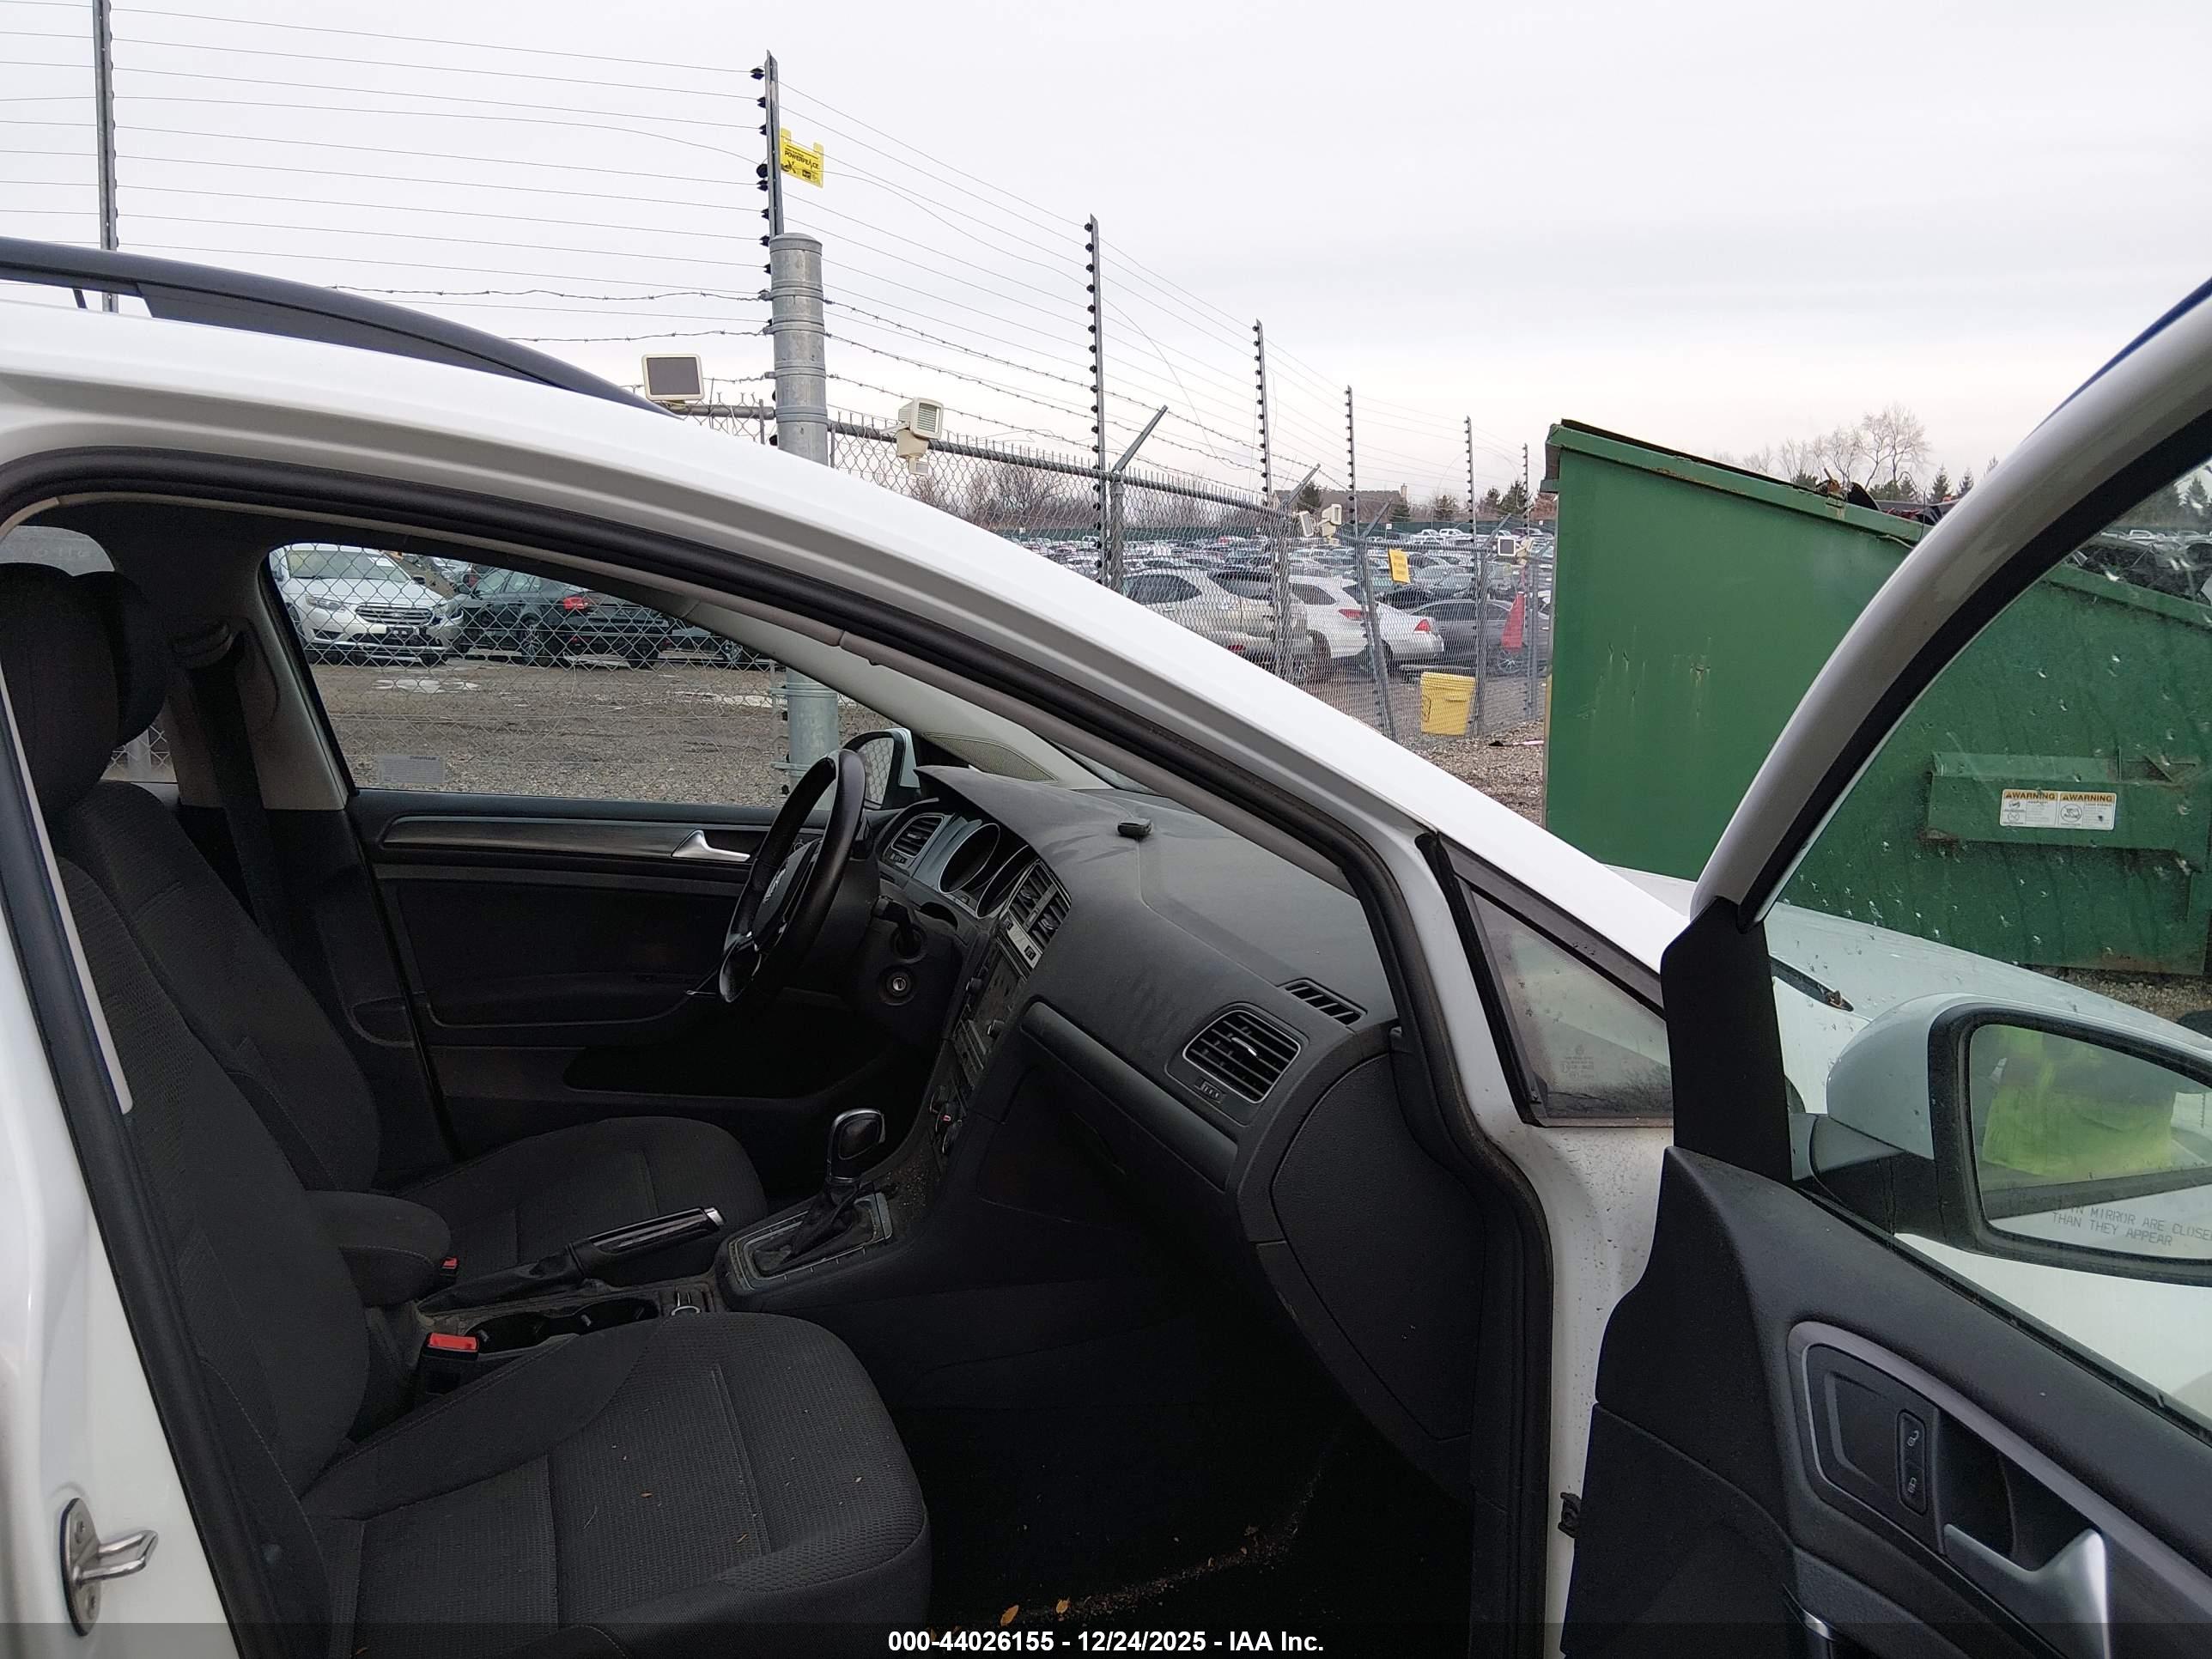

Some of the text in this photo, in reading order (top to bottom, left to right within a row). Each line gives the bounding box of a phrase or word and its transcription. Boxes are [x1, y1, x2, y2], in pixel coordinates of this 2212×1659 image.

[2069, 793, 2112, 802] WARNING
[2053, 1212, 2172, 1246] THAN THEY APPEAR
[2090, 1206, 2136, 1225] MIRROR
[2142, 1217, 2166, 1231] ARE
